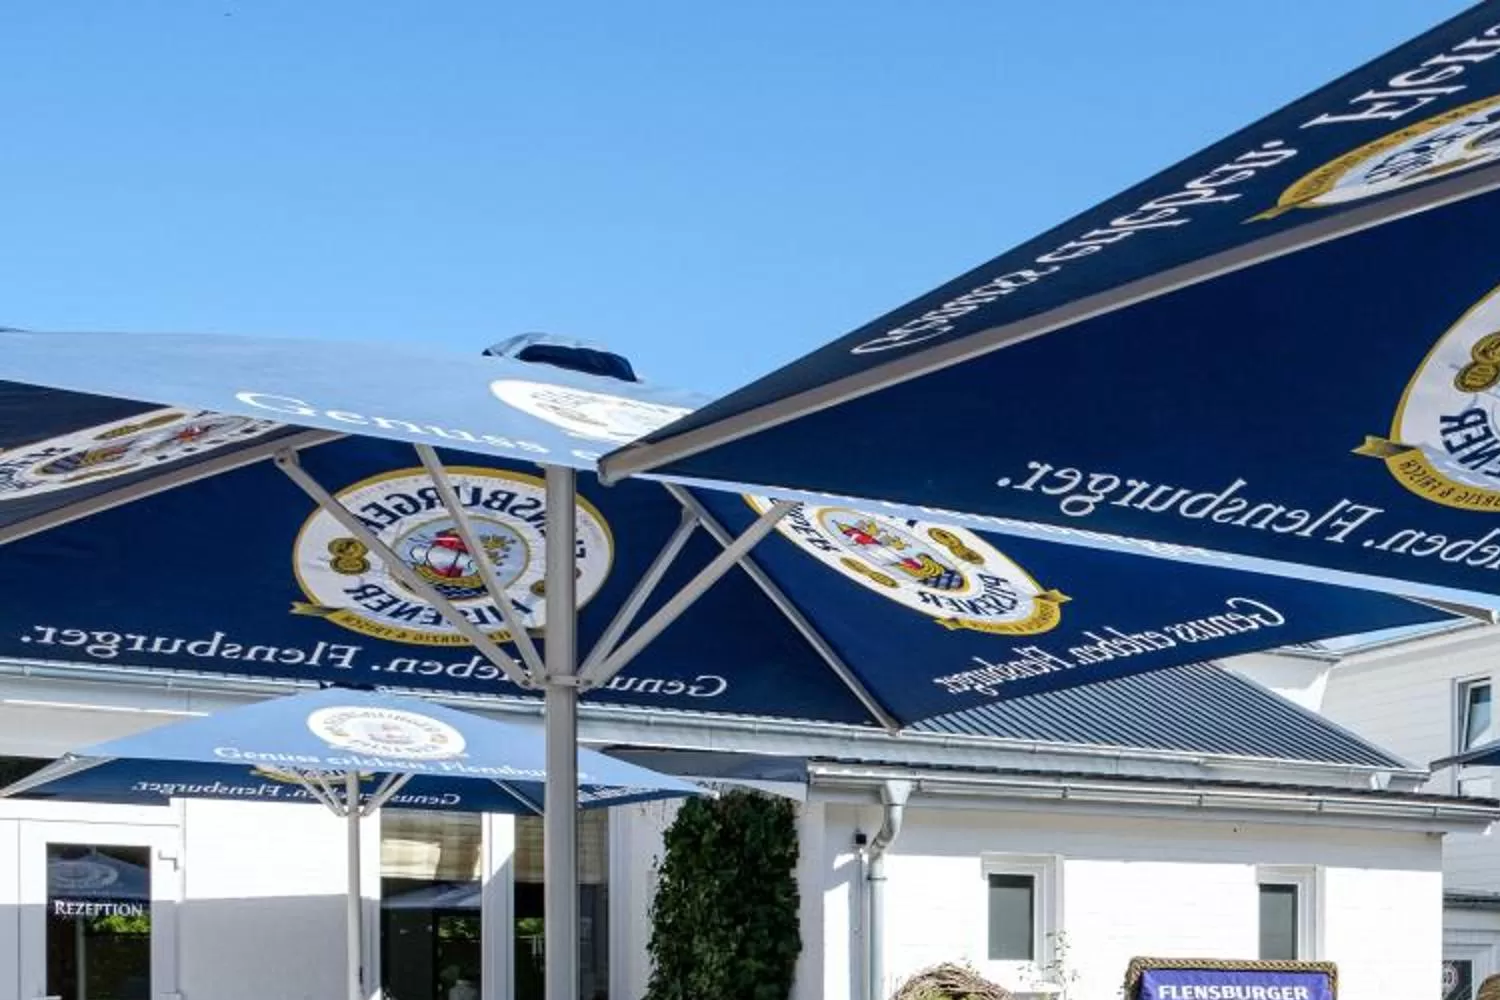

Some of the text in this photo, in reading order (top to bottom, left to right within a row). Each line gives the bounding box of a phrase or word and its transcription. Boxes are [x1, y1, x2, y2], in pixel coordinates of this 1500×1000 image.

[235, 391, 550, 455] Genuss
[54, 899, 144, 917] REZEPTION
[1158, 984, 1310, 1000] FLENSBURGER
